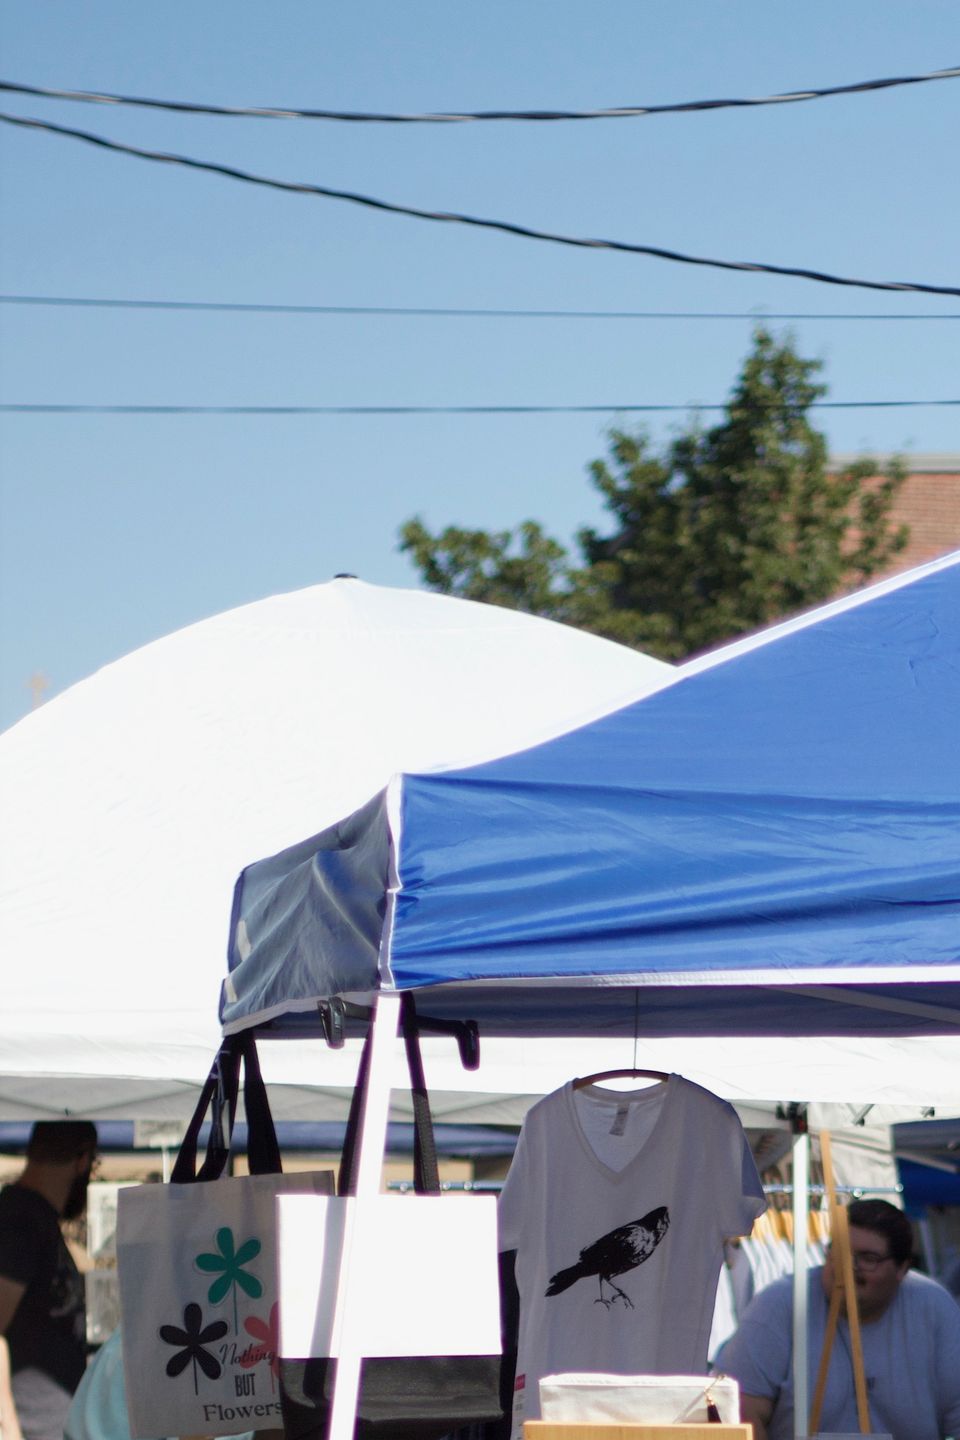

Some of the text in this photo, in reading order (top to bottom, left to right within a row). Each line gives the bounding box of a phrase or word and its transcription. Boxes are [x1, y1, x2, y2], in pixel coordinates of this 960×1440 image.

[219, 1342, 277, 1367] Nothing
[235, 1373, 256, 1397] BUT
[202, 1401, 282, 1421] Flowers
